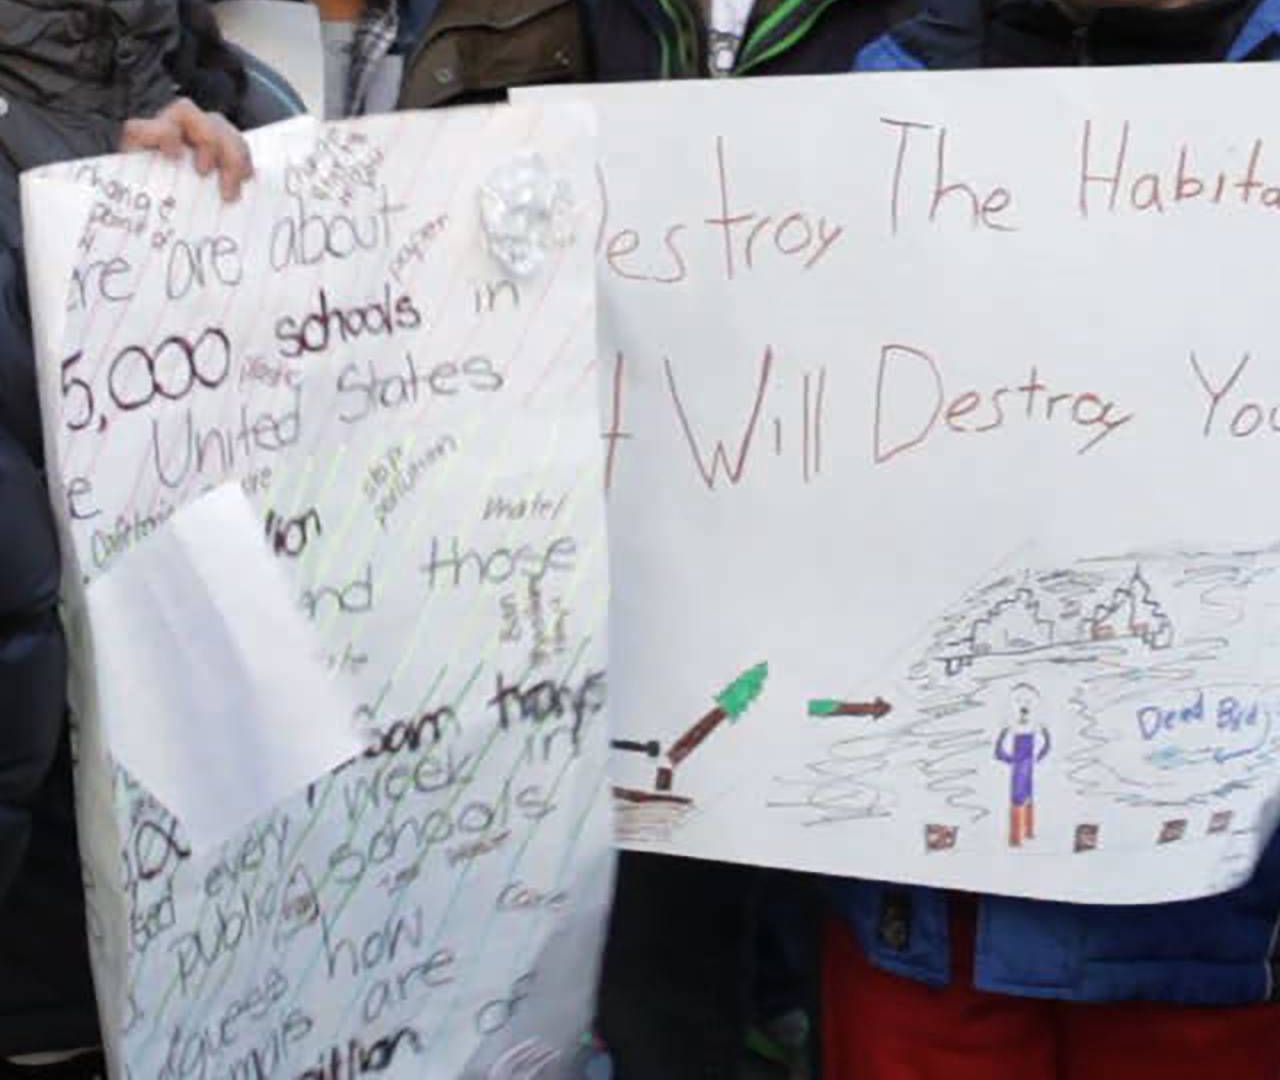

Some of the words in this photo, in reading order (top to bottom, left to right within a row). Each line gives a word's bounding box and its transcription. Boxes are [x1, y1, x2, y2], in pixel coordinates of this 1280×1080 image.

[879, 117, 1018, 236] The
[165, 234, 242, 301] are
[270, 182, 409, 273] about
[275, 284, 421, 360] schools
[474, 278, 520, 314] in
[151, 378, 302, 489] United
[336, 350, 505, 425] States
[664, 343, 828, 491] Will
[419, 534, 577, 591] those
[327, 775, 558, 889] schools
[363, 947, 456, 1023] are
